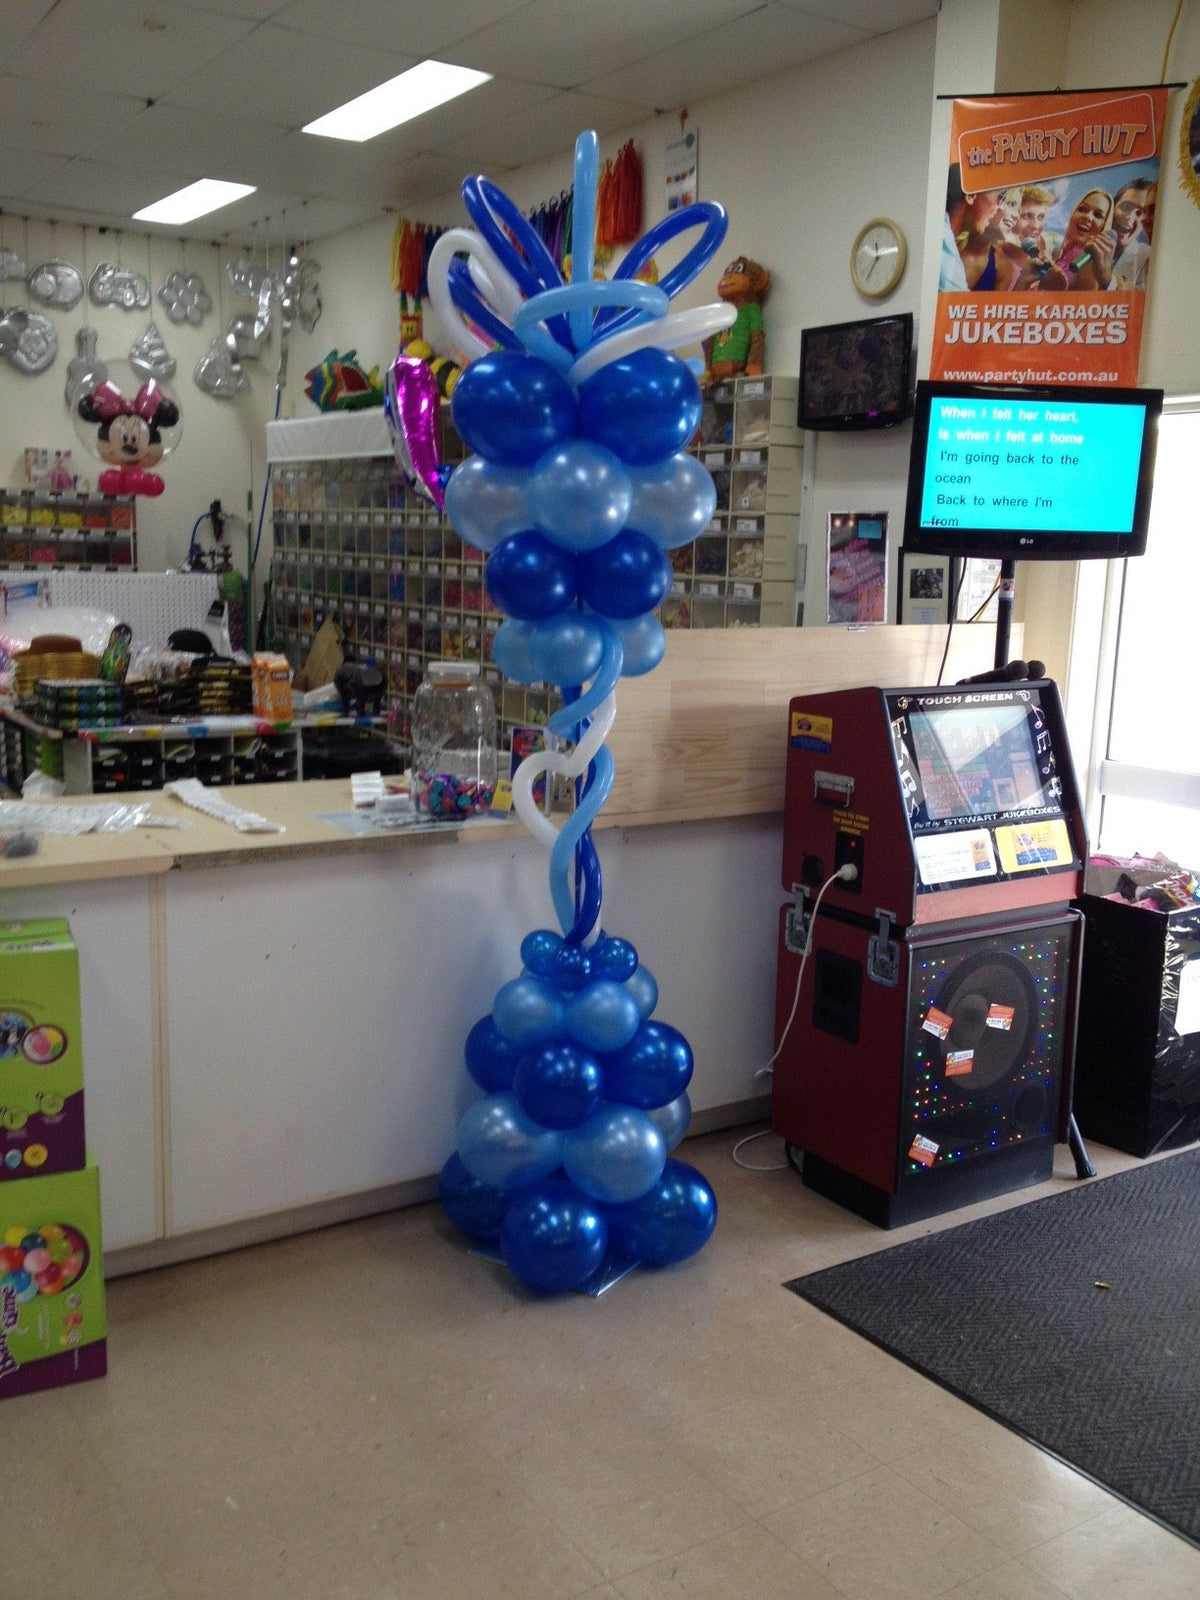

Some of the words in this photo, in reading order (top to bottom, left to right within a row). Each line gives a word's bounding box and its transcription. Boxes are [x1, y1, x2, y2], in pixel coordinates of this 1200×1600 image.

[967, 145, 992, 167] the
[992, 127, 1078, 164] PARTY
[1082, 123, 1147, 155] HUT
[948, 304, 978, 320] WE
[984, 304, 1029, 320] HIRE
[1034, 304, 1130, 320] KARAOKE
[944, 321, 1128, 346] JUKEBOXES
[943, 368, 1118, 384] www.partyhut.com.au
[940, 406, 976, 419] When
[992, 408, 1013, 420] felt
[1018, 410, 1039, 421] her
[957, 429, 989, 441] when
[1006, 431, 1025, 443] felt
[1032, 433, 1043, 443] at
[1050, 432, 1084, 444] home
[940, 451, 958, 462] I'm
[965, 452, 999, 465] going
[1006, 453, 1035, 464] back
[1042, 454, 1054, 465] to
[1060, 454, 1079, 465] the
[935, 474, 971, 484] ocean
[937, 494, 966, 505] Back
[973, 495, 985, 506] to
[992, 496, 1028, 507] where
[1035, 496, 1053, 507] I'm
[931, 516, 959, 526] from
[917, 695, 962, 705] TOUCH
[965, 693, 1013, 704] SCREEN
[943, 813, 998, 826] STEWART
[1000, 805, 1061, 820] JUKEBOXES
